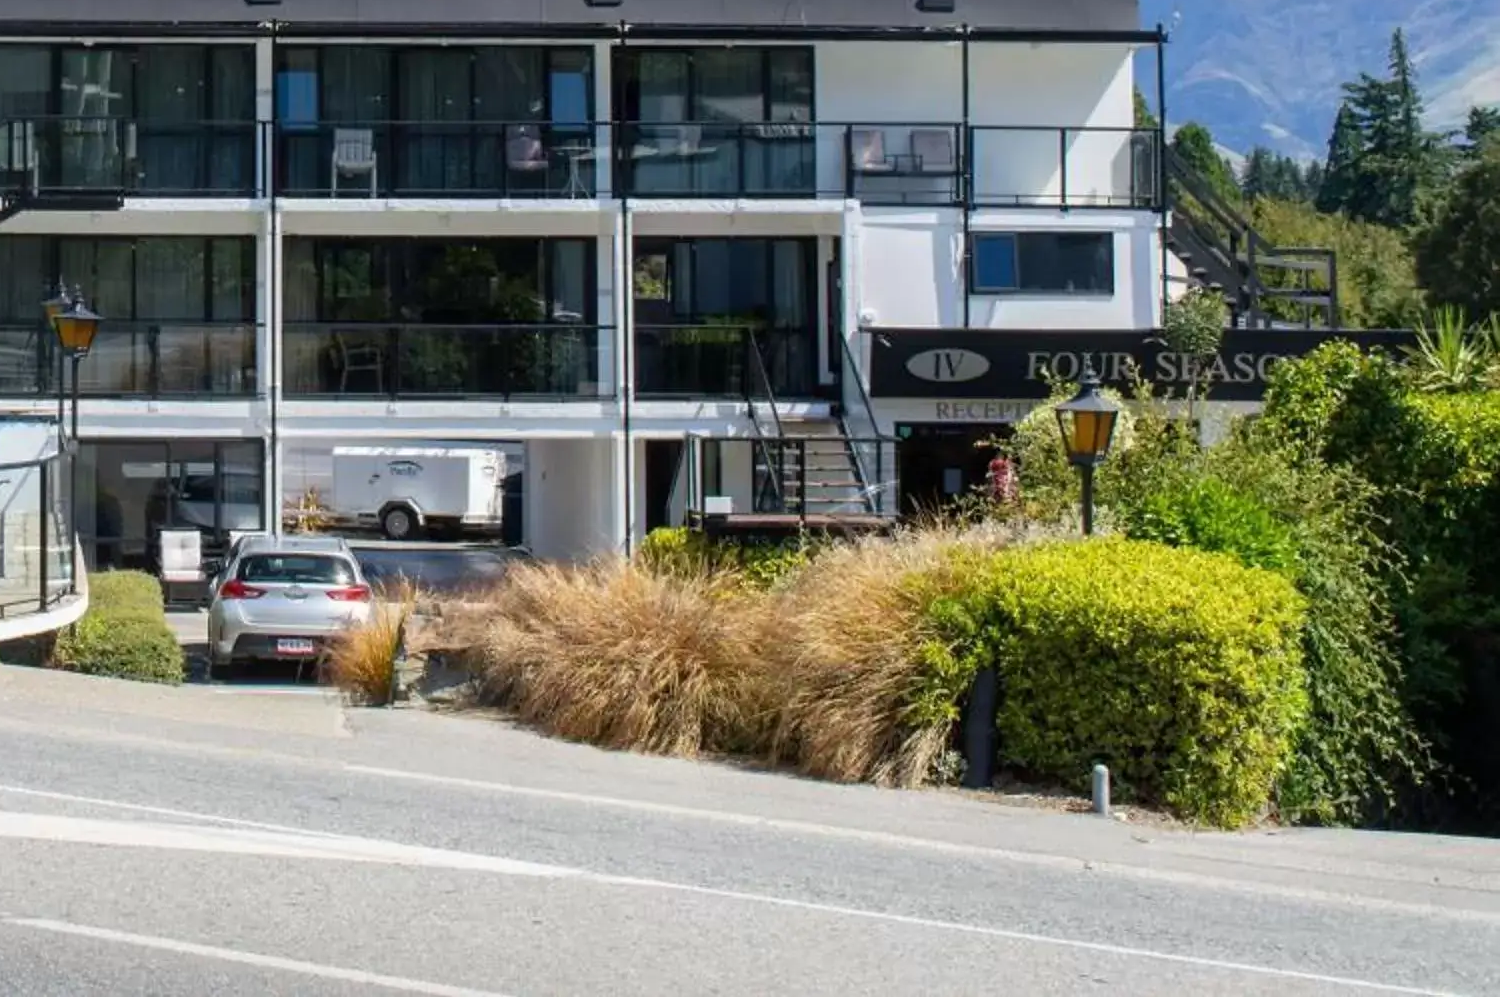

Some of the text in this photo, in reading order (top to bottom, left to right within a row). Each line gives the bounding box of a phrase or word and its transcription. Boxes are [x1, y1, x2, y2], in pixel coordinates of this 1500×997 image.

[934, 352, 964, 379] IV
[1026, 351, 1296, 382] FOUR SEASO
